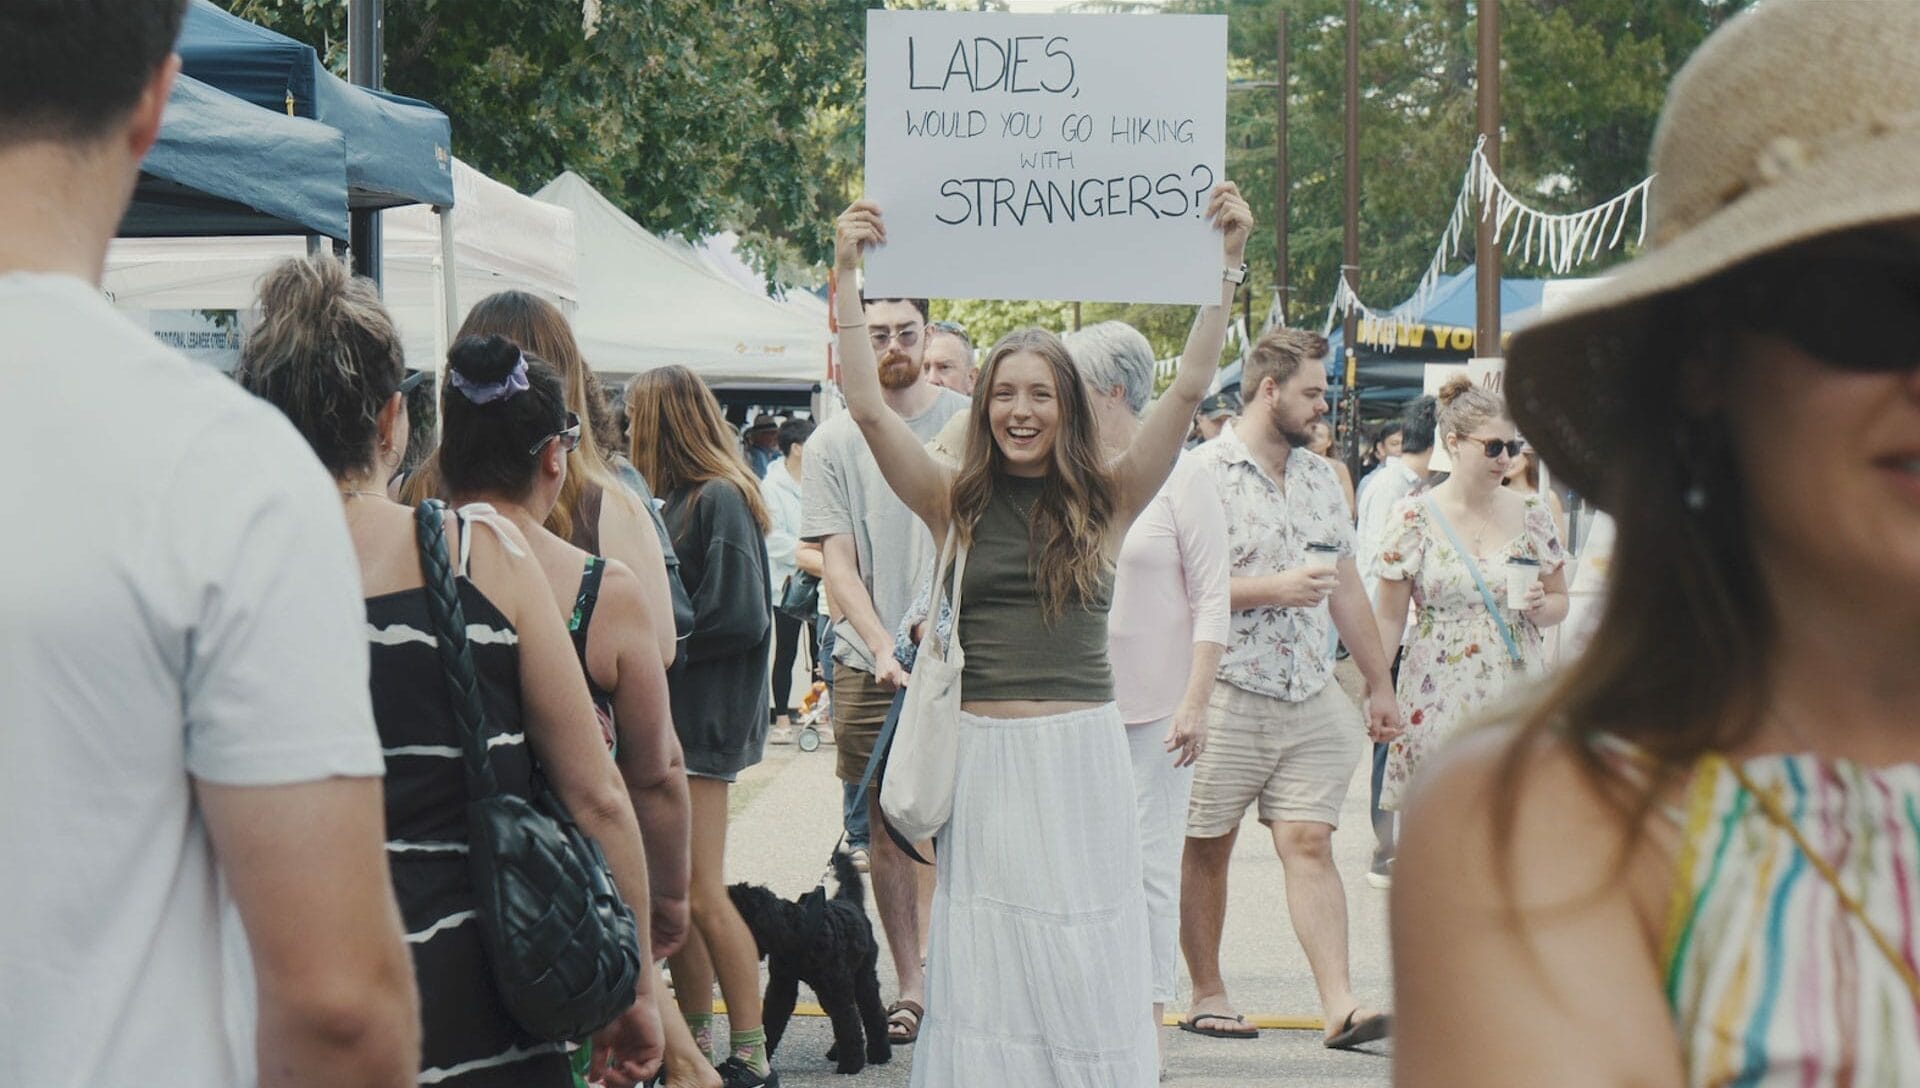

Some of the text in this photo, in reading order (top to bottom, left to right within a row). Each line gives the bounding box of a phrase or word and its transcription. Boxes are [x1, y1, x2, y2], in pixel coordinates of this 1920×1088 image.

[908, 36, 1080, 99] LADIES,
[906, 110, 1195, 145] WOULD YOU GO HIKING
[1020, 151, 1075, 170] WITH
[935, 164, 1214, 227] STRANGERS?
